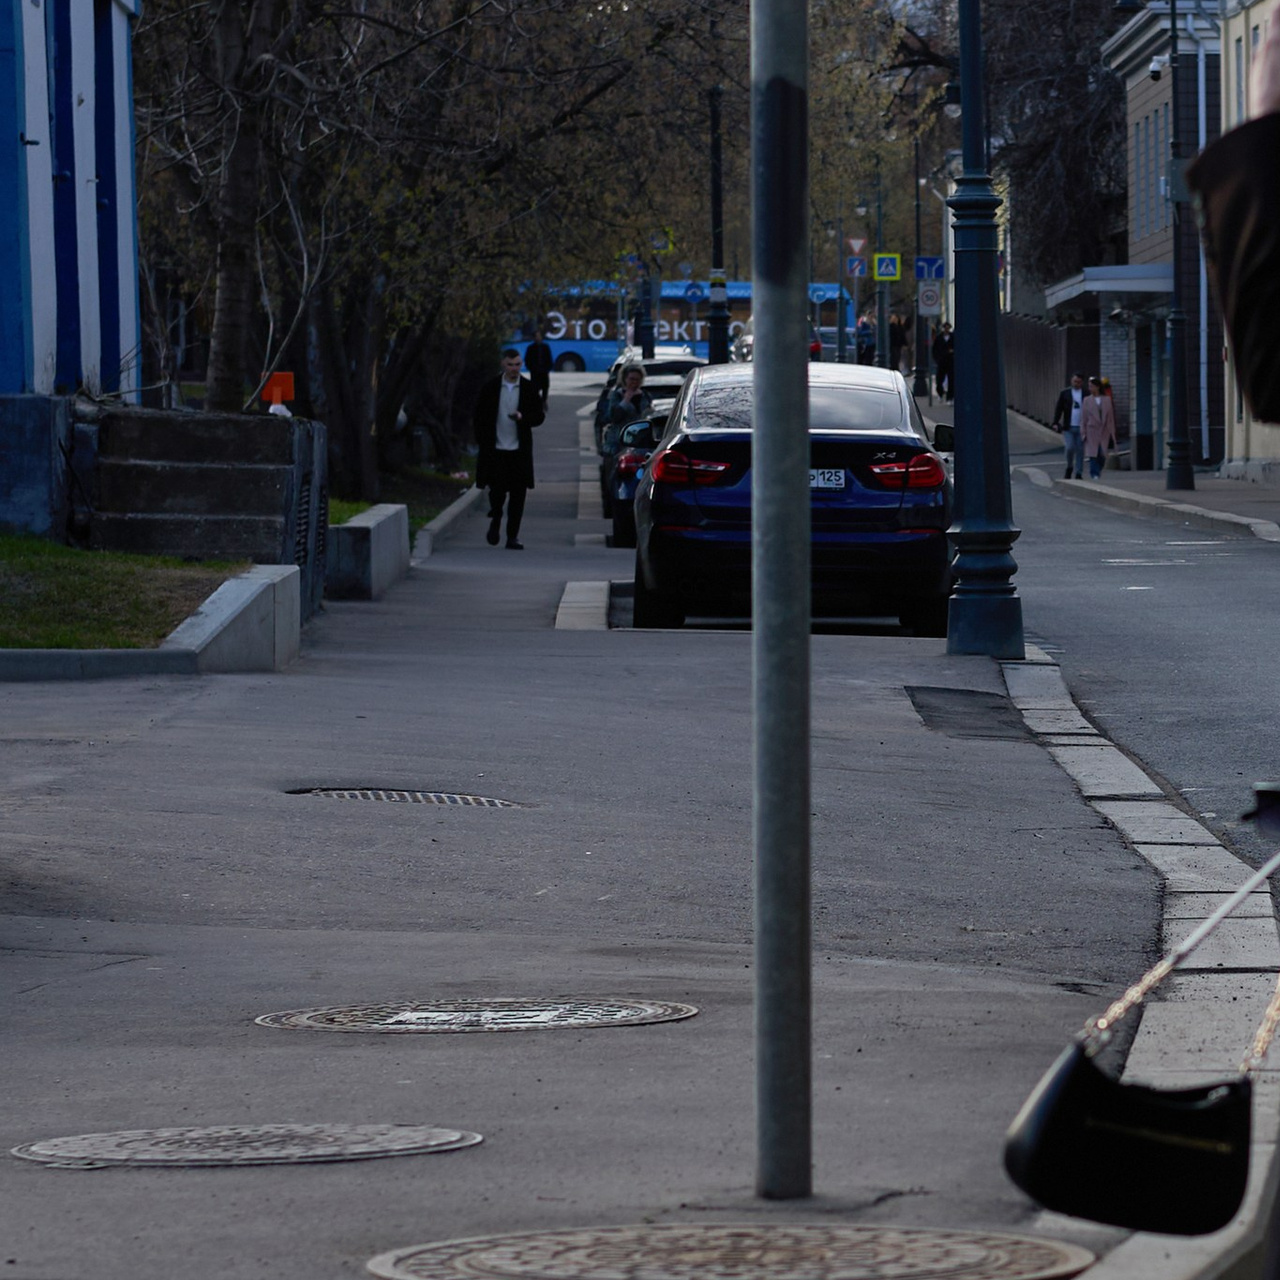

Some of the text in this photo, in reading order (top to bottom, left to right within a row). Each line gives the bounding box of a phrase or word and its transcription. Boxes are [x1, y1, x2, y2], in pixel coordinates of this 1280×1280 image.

[545, 311, 606, 340] Это
[873, 452, 896, 460] X4
[819, 470, 842, 482] 125
